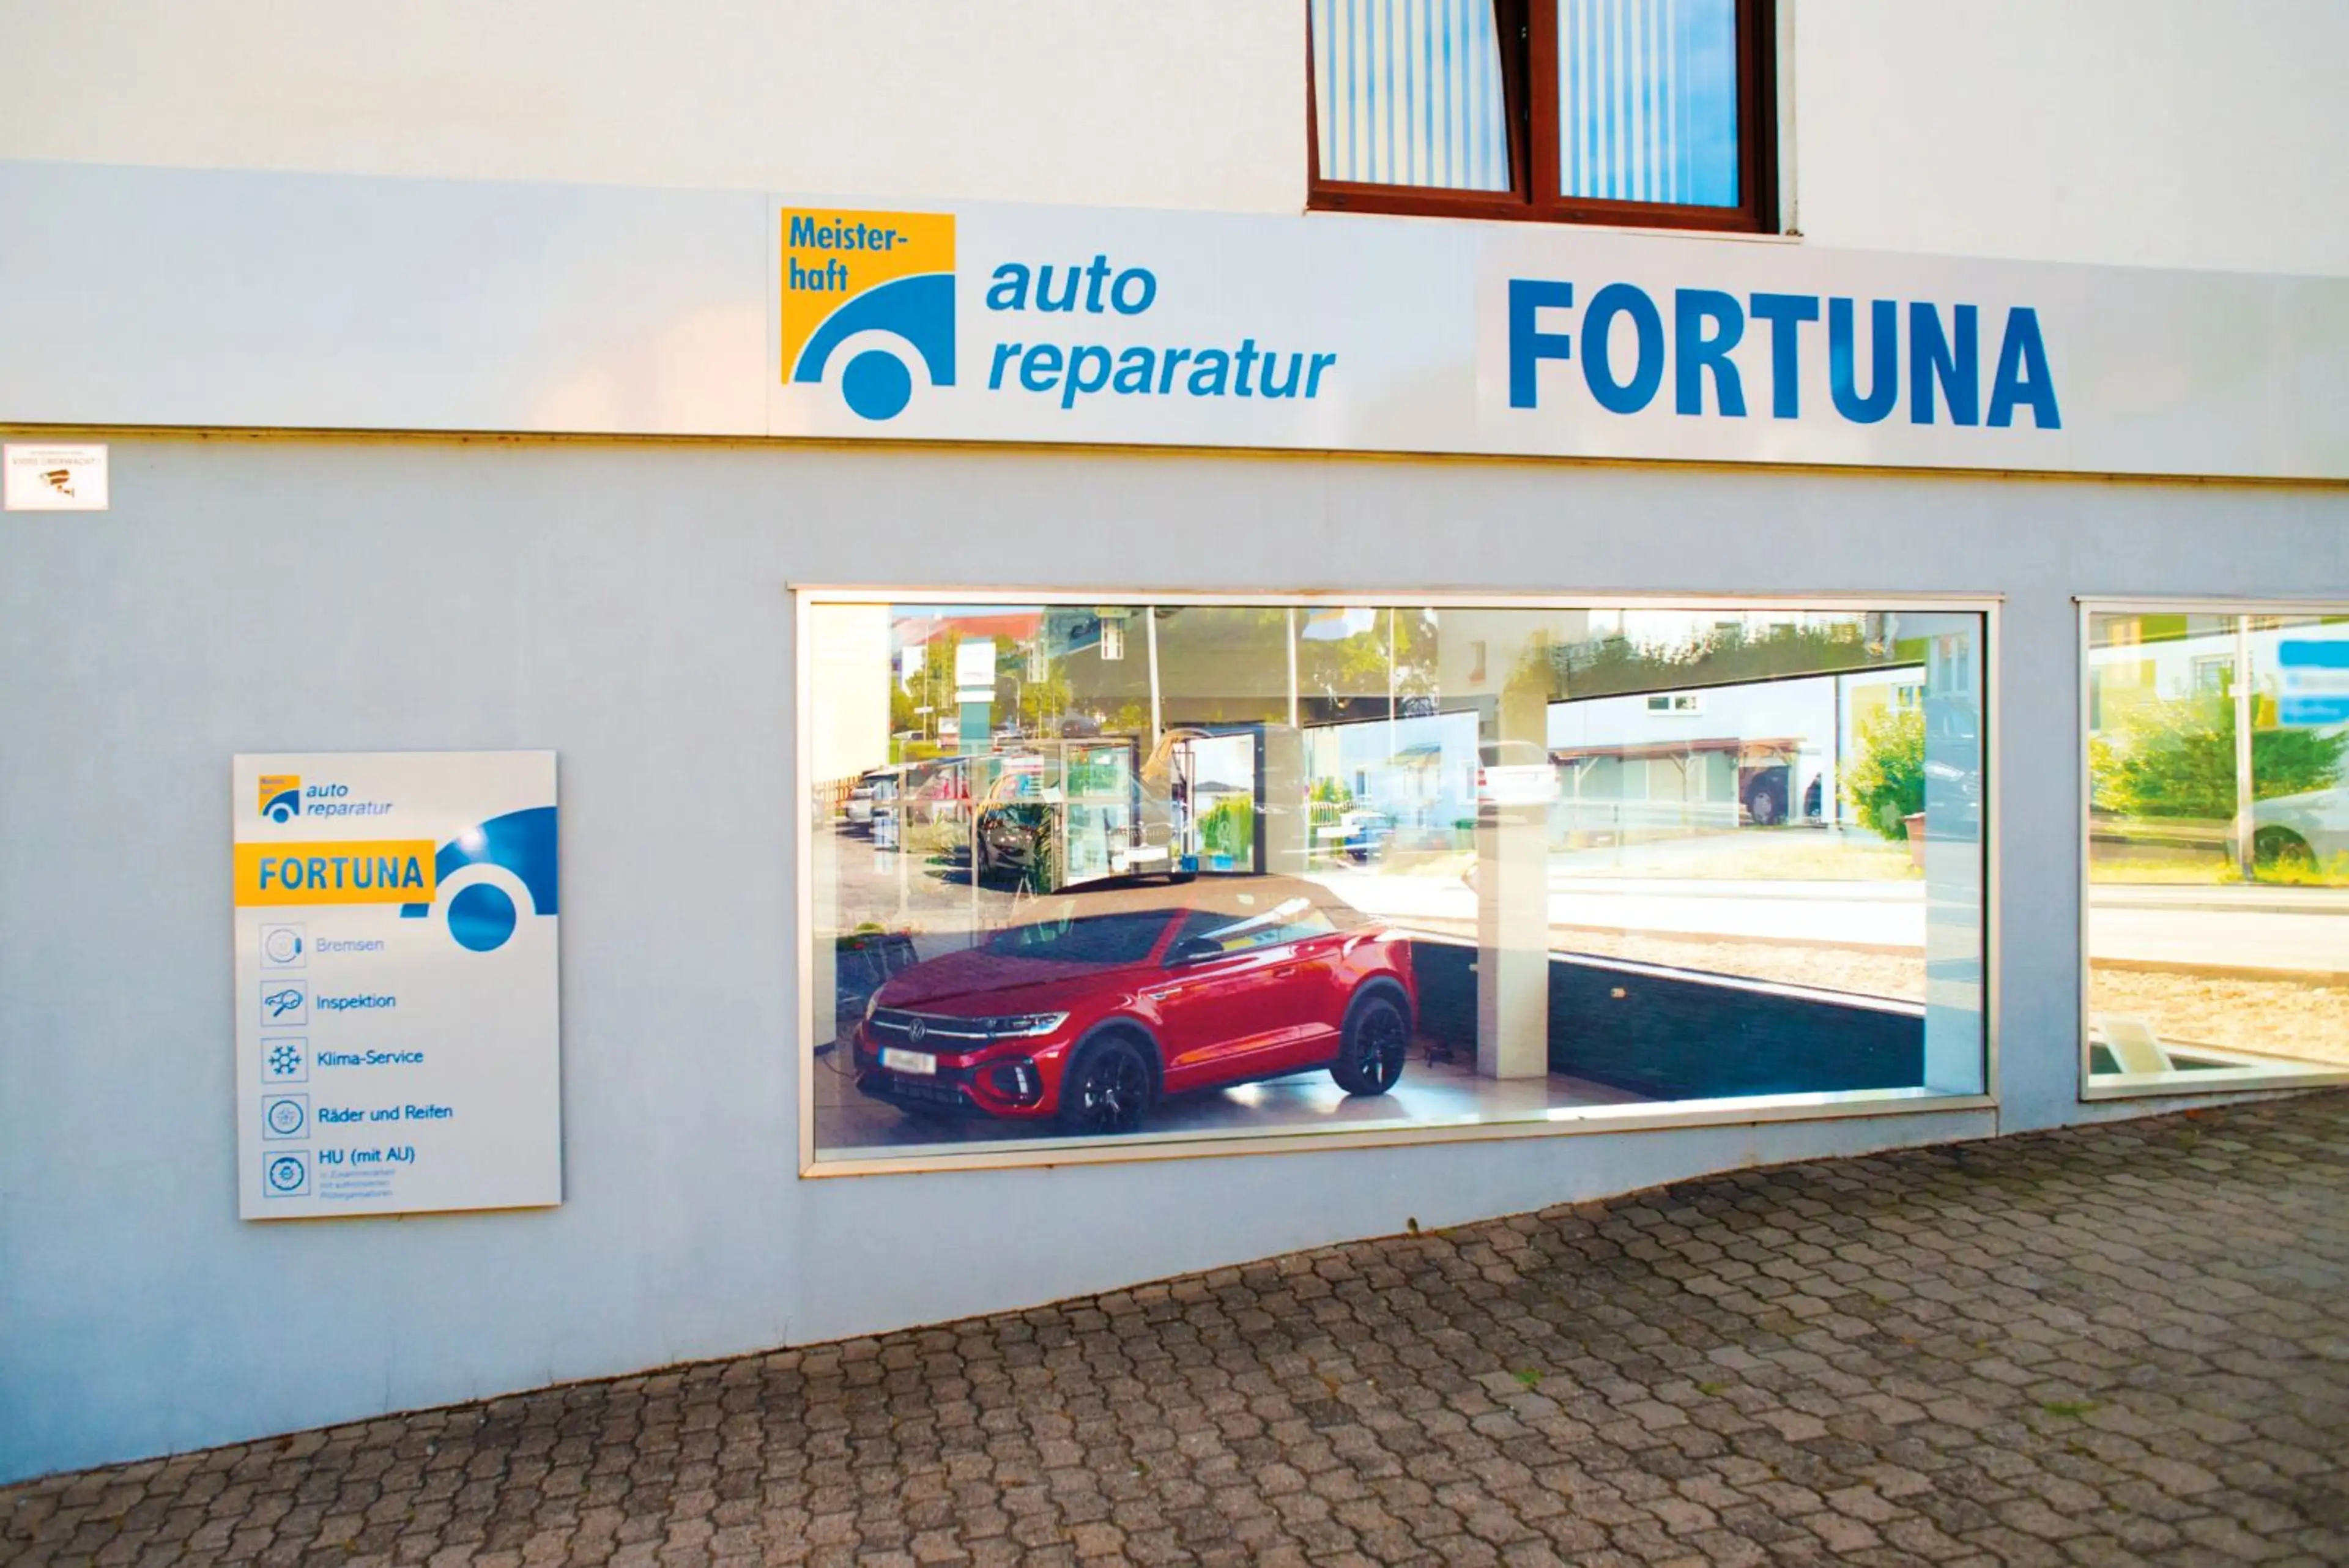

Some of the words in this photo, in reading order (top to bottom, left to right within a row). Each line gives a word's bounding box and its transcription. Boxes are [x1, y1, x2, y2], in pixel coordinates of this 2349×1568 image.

[790, 217, 908, 250] Meister-
[790, 258, 848, 291] haft
[986, 254, 1157, 315] auto
[1509, 278, 2061, 430] FORTUNA
[988, 338, 1337, 410] reparatur
[306, 783, 349, 798] auto
[307, 801, 393, 820] reparatur
[259, 856, 423, 890] FORTUNA
[316, 937, 384, 952] Bremsen
[316, 993, 396, 1013] Inspektion
[317, 1049, 424, 1067] Klima-Service
[317, 1107, 365, 1123] Räder
[369, 1105, 400, 1121] und
[404, 1104, 454, 1120] Reifen
[318, 1149, 344, 1164] HU
[351, 1148, 382, 1167] (mit
[386, 1145, 416, 1164] AU)
